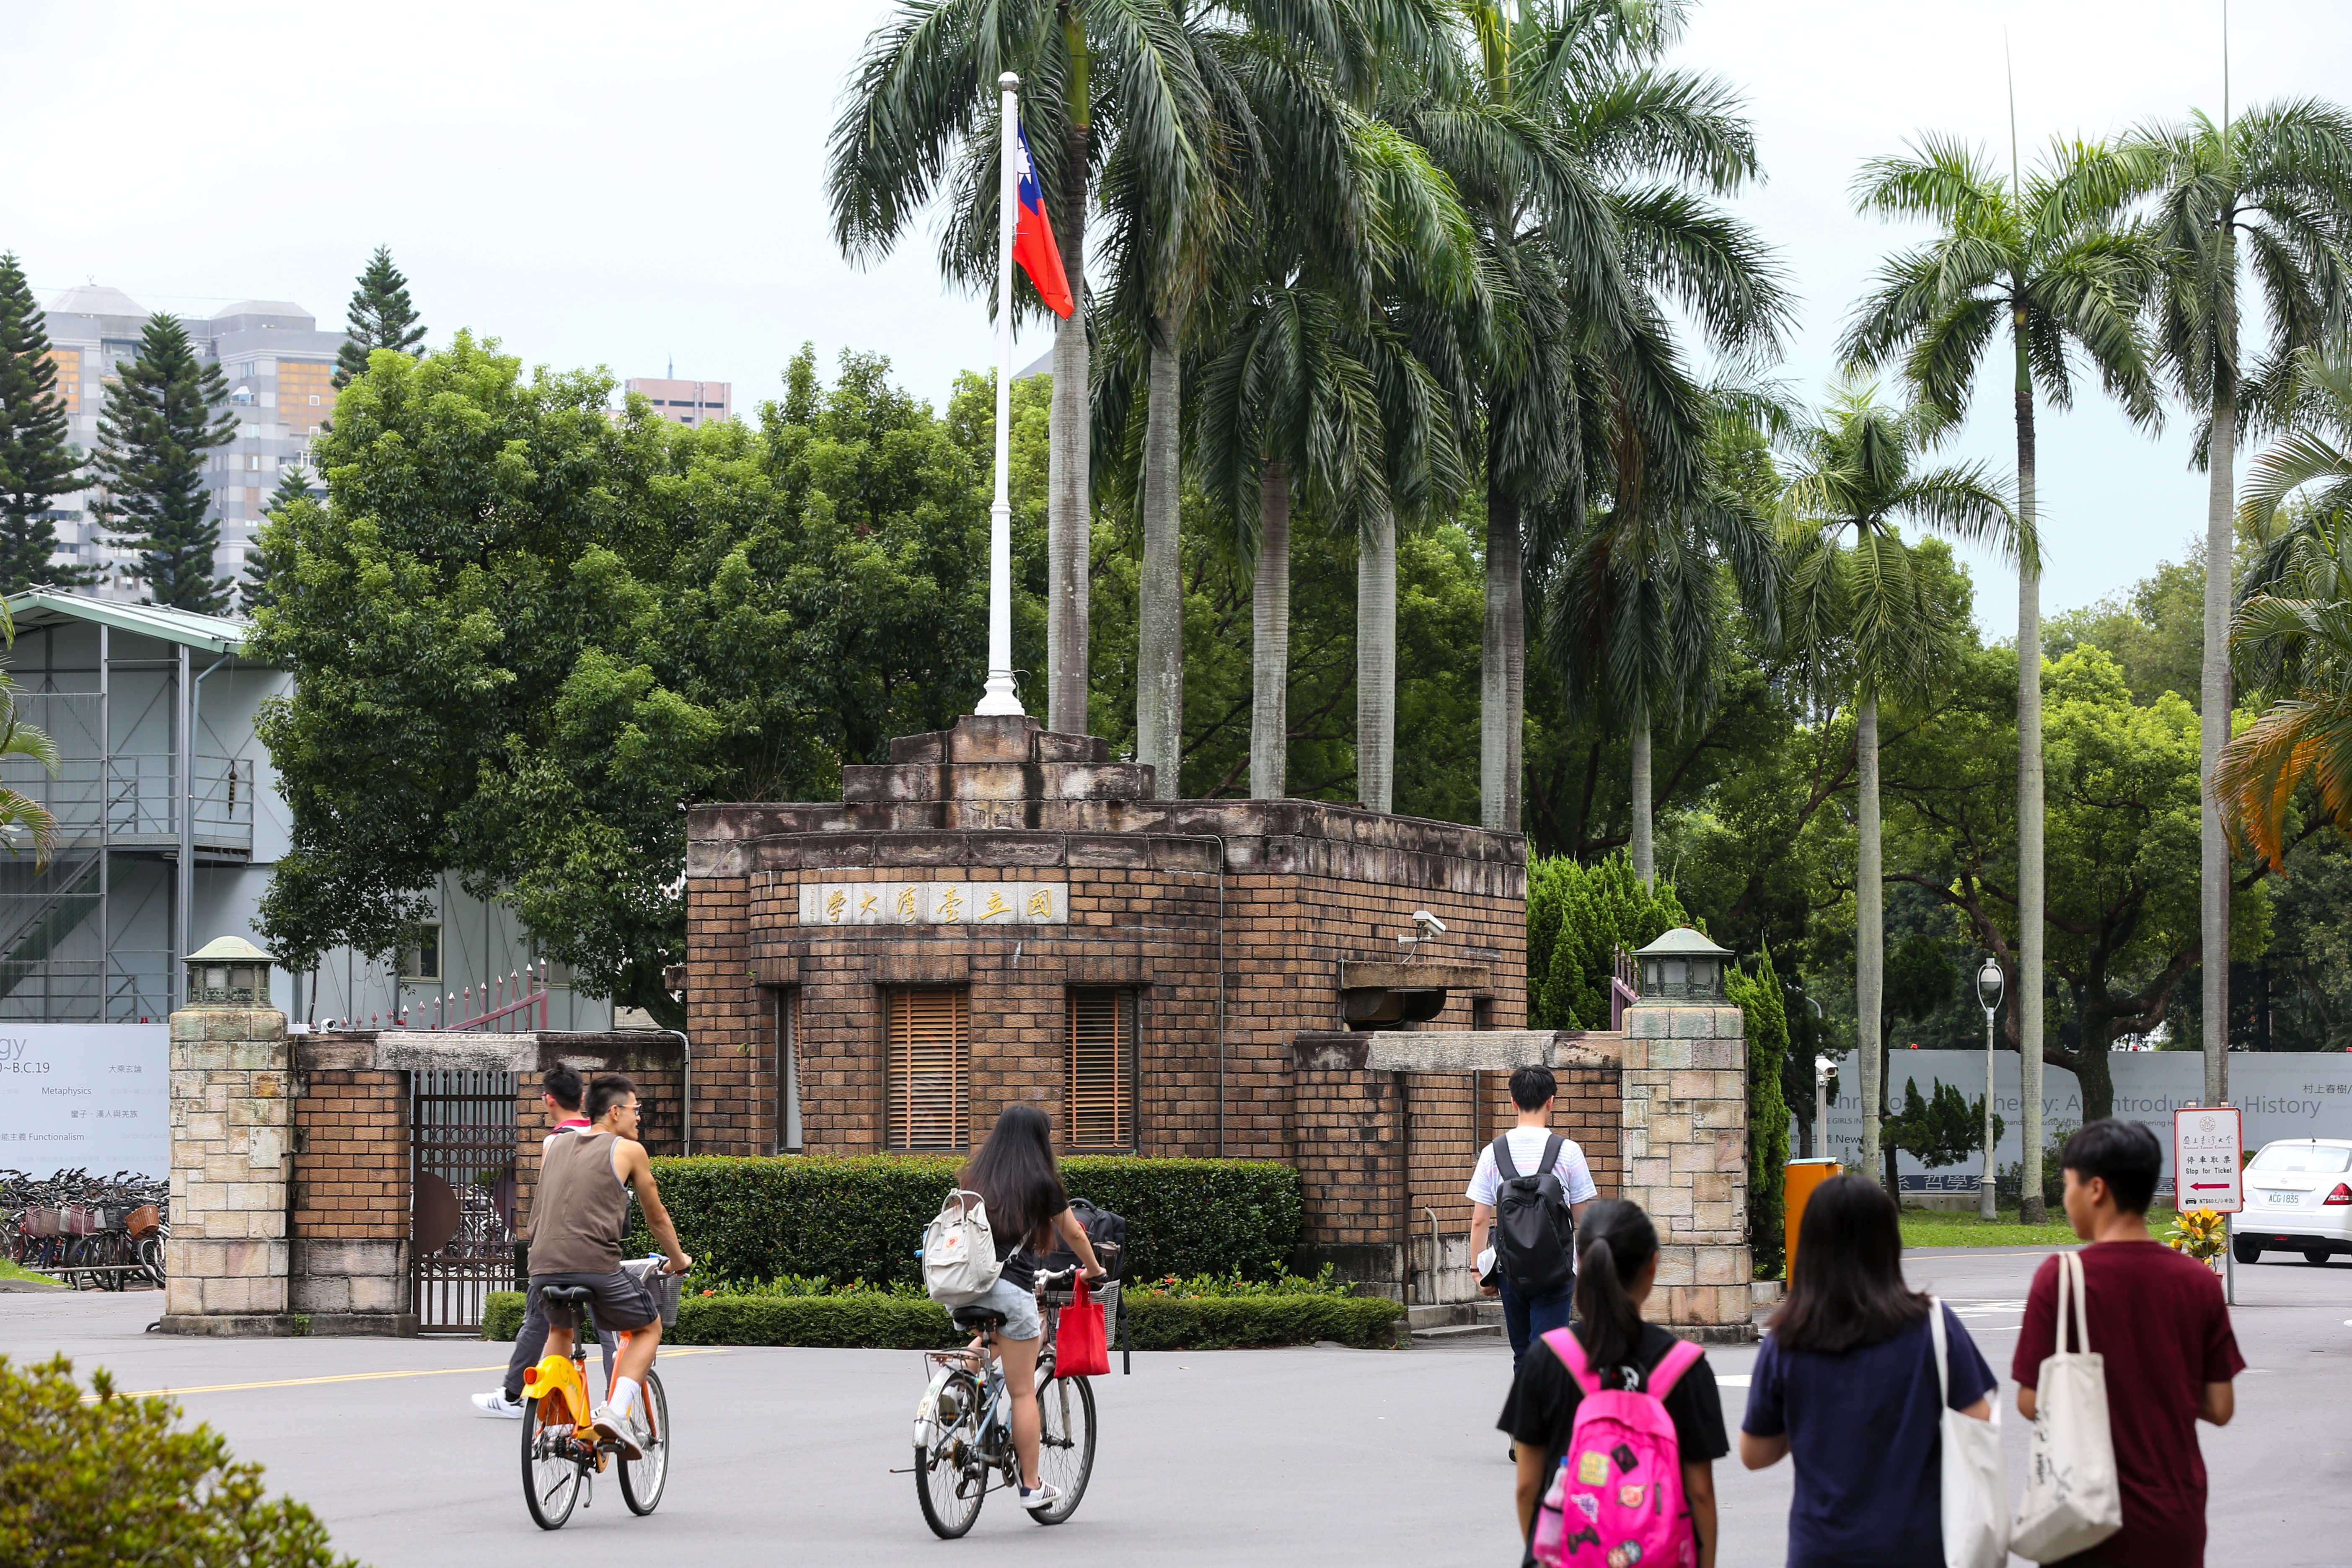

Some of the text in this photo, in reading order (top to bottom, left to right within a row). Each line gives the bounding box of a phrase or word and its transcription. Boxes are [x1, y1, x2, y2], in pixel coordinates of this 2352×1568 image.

[42, 1087, 91, 1096] Metaphysics
[2245, 1095, 2321, 1118] History
[2187, 1155, 2231, 1164] 停車取票
